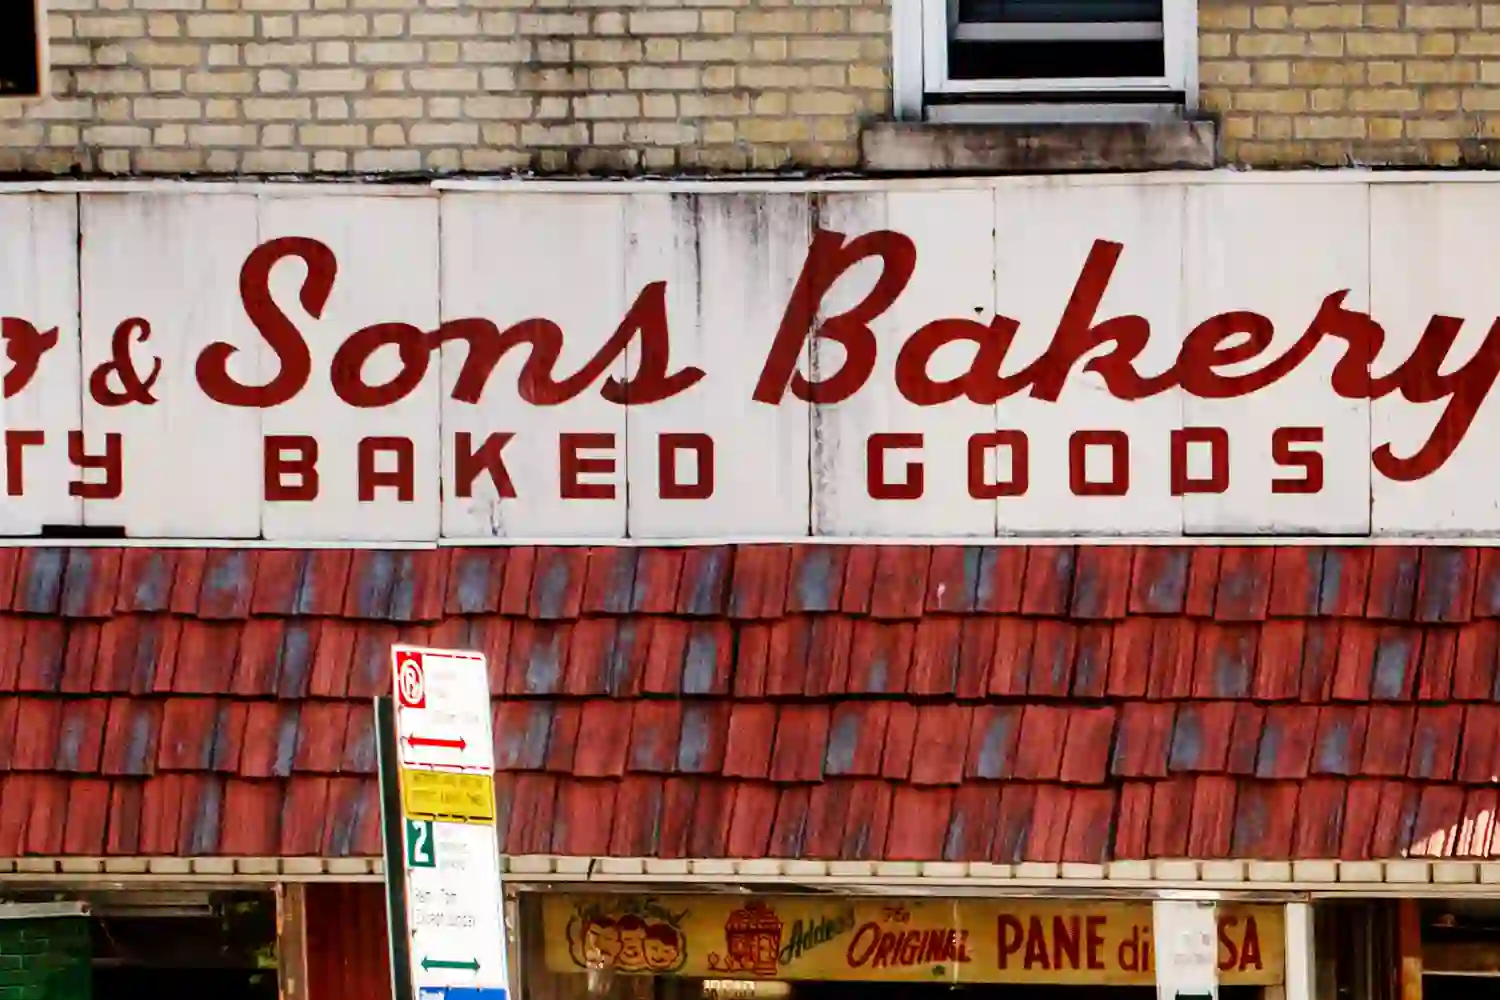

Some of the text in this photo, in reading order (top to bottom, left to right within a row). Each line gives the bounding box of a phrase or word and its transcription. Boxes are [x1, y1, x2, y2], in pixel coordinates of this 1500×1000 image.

[90, 317, 161, 406] &
[196, 236, 706, 407] Sons
[263, 431, 715, 501] BAKED
[867, 425, 1325, 500] GOODS
[411, 819, 430, 862] 2
[997, 914, 1108, 971] PANE
[1117, 924, 1150, 972] di
[1216, 914, 1264, 972] SA
